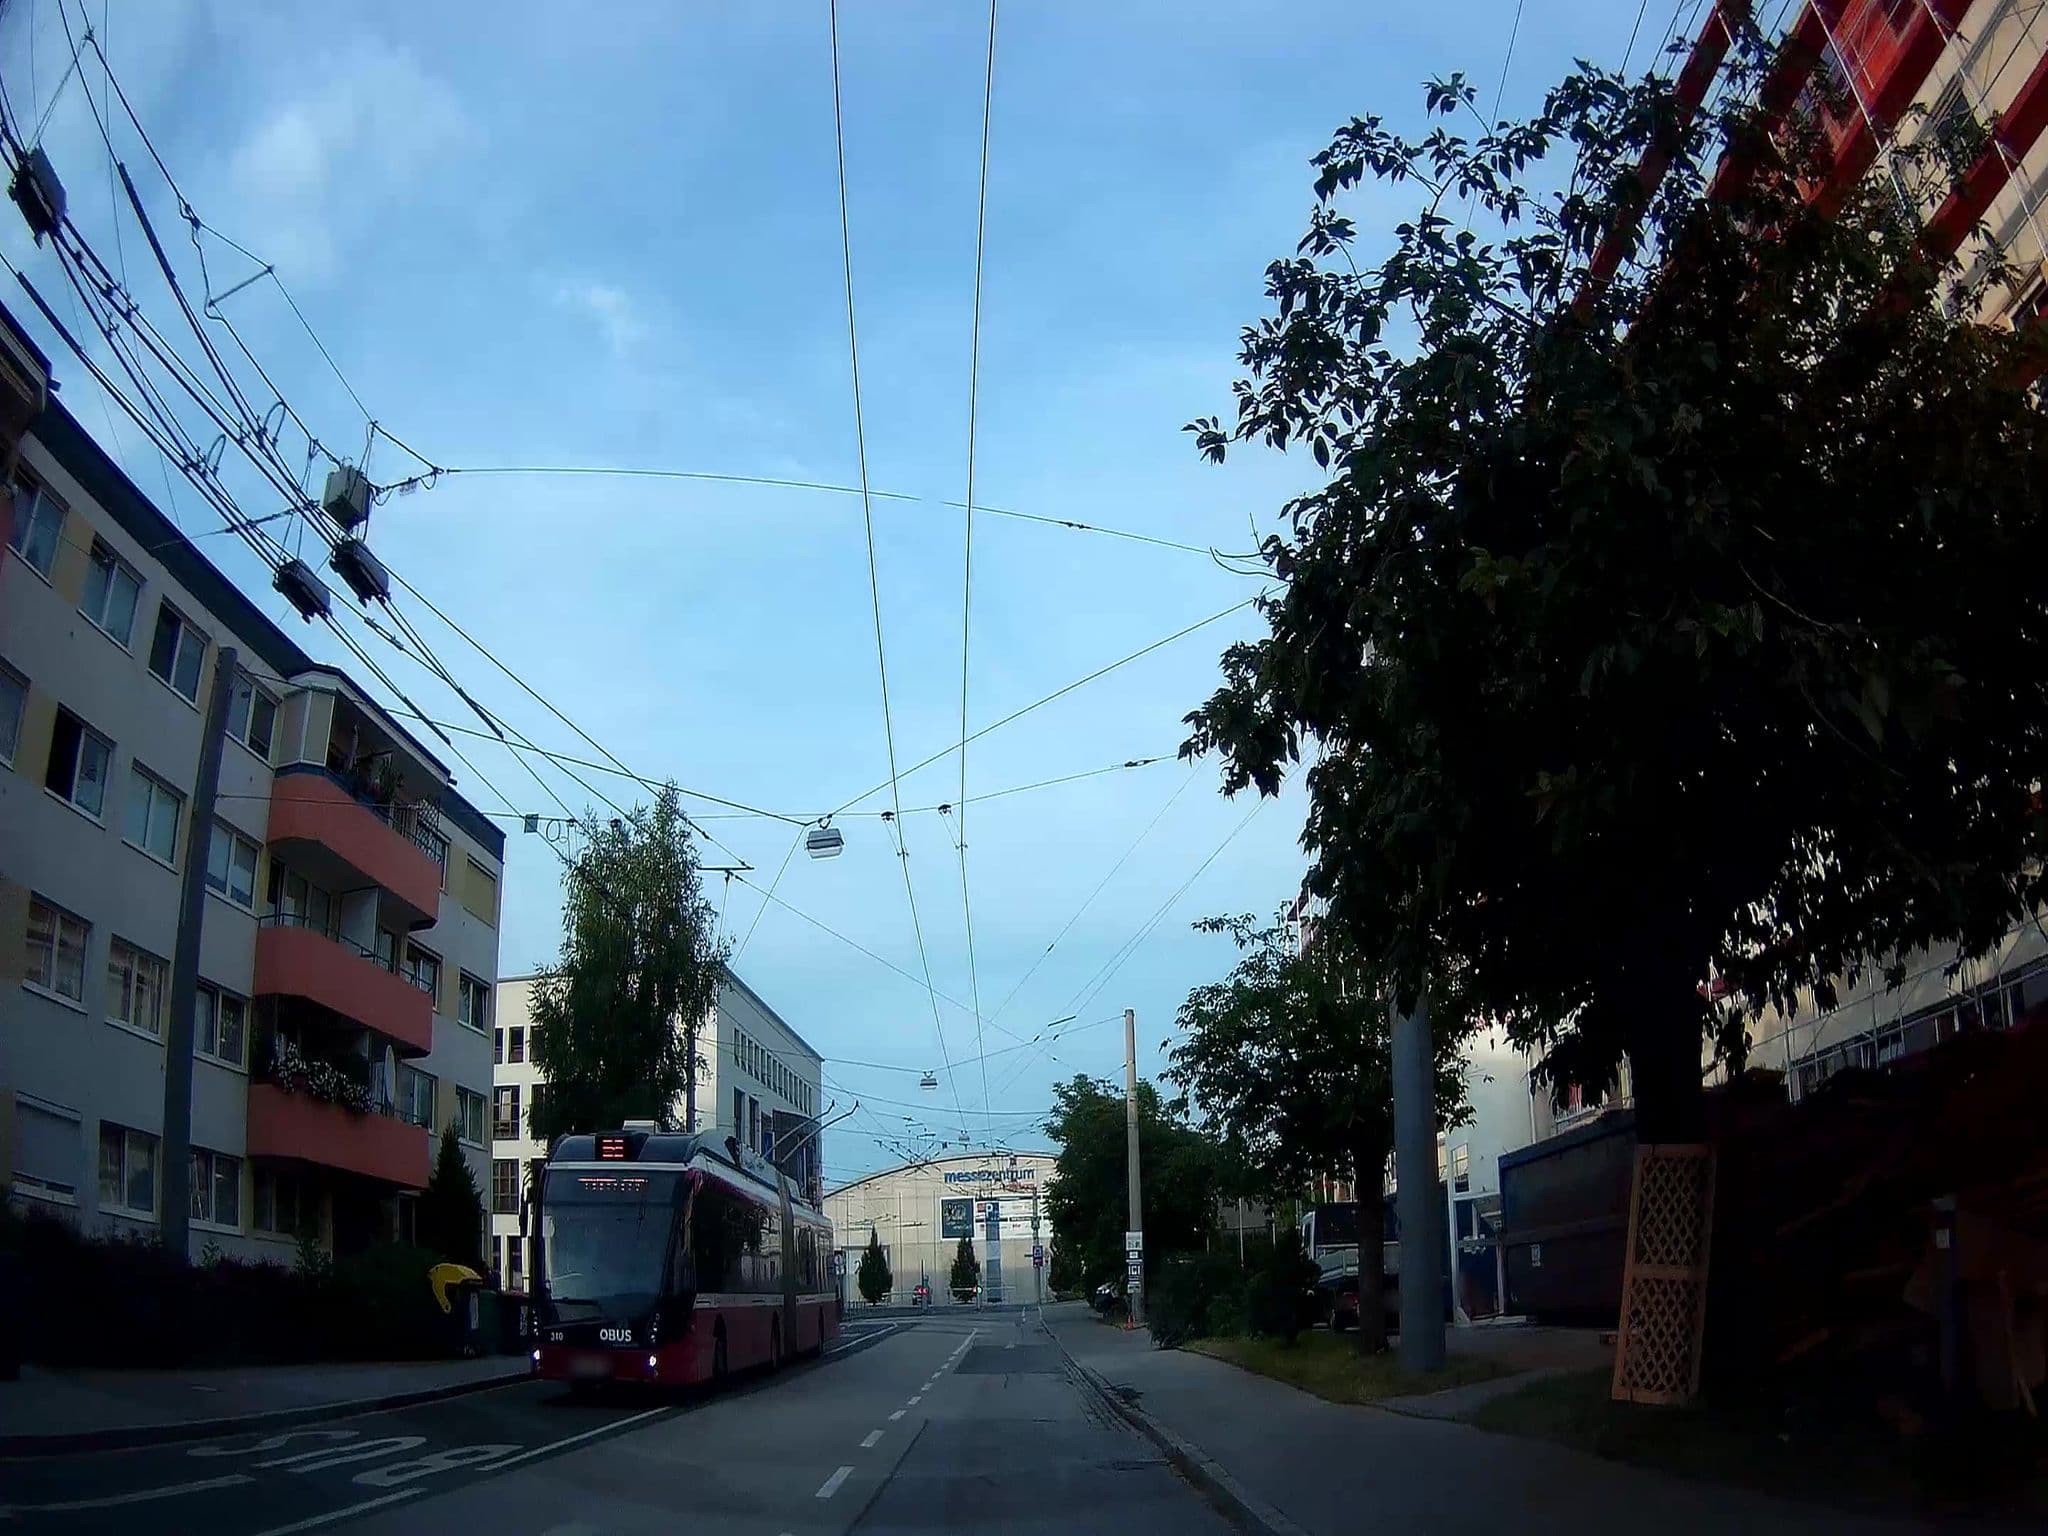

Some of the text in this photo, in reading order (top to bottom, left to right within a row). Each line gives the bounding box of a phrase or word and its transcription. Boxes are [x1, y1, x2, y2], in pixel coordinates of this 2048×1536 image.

[944, 1168, 1036, 1183] messezentrum
[599, 1328, 632, 1342] OBUS
[186, 1430, 524, 1486] BUS
